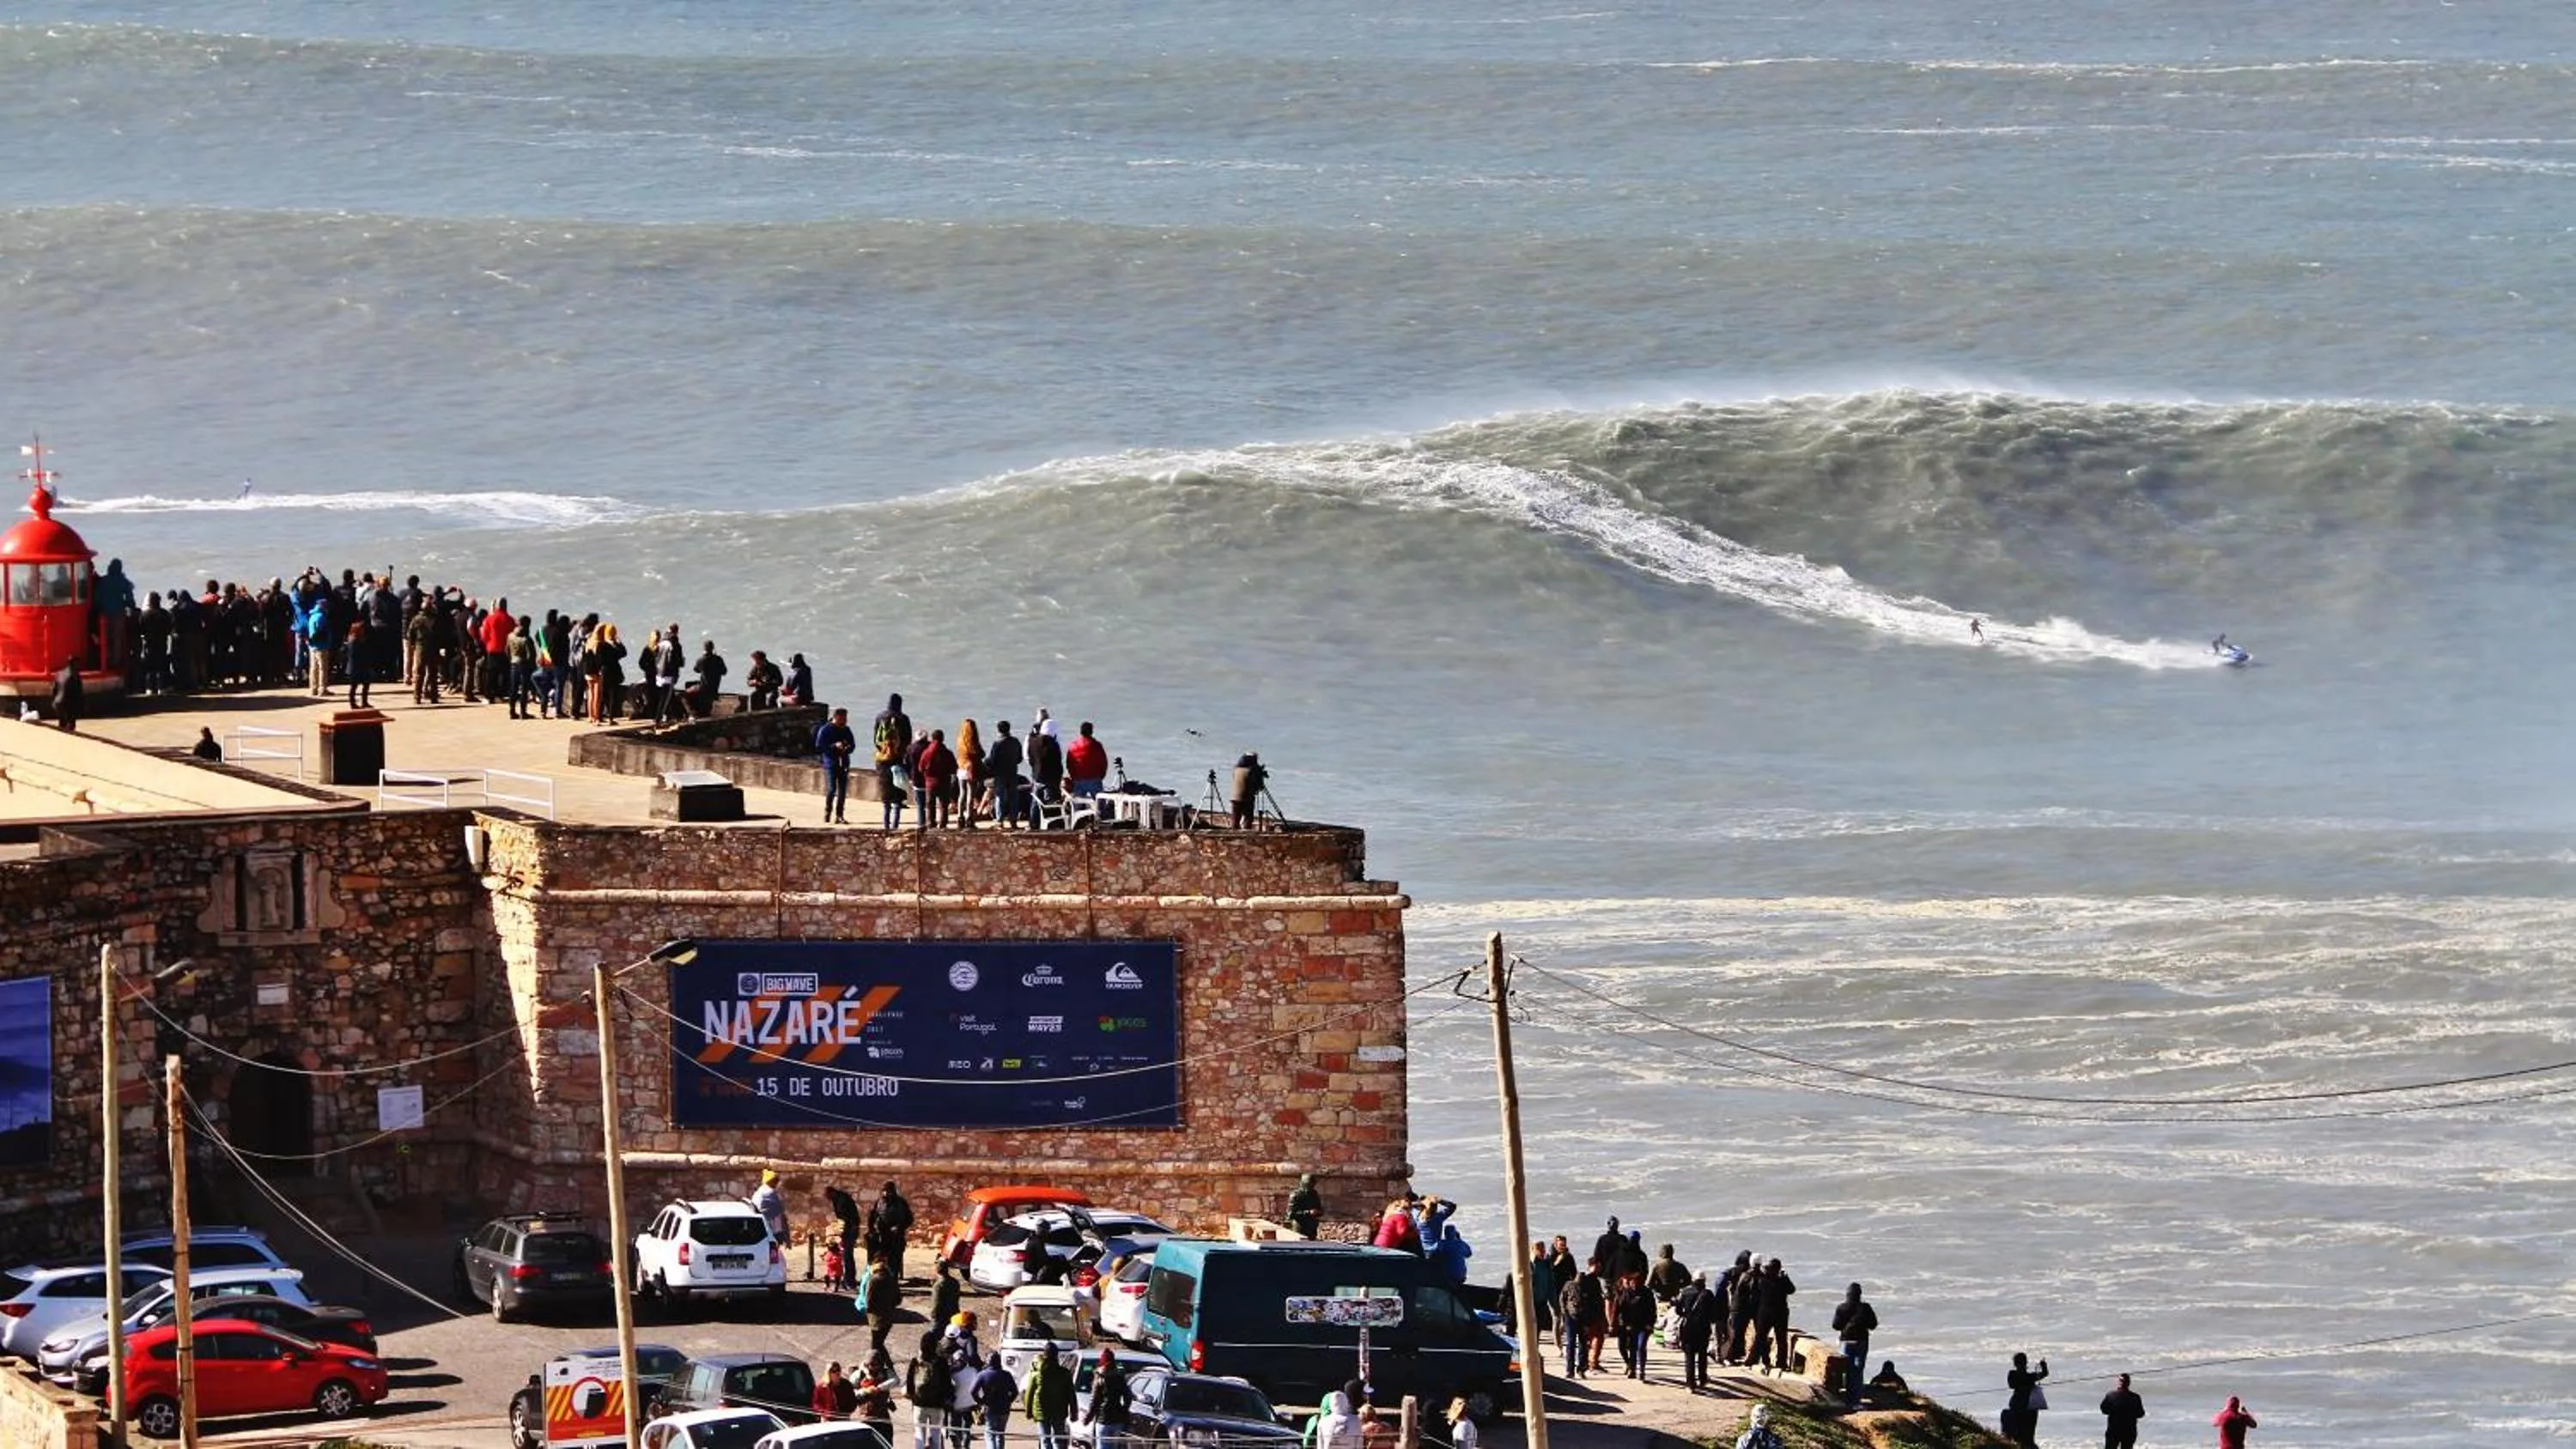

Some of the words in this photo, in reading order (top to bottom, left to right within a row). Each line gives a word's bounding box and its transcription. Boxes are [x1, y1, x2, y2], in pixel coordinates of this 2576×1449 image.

[1022, 973, 1063, 986] Corona
[703, 985, 861, 1045] NAZARÉ
[756, 1077, 779, 1096] 15
[789, 1077, 811, 1096] DE
[822, 1077, 899, 1096] OUTUBRO
